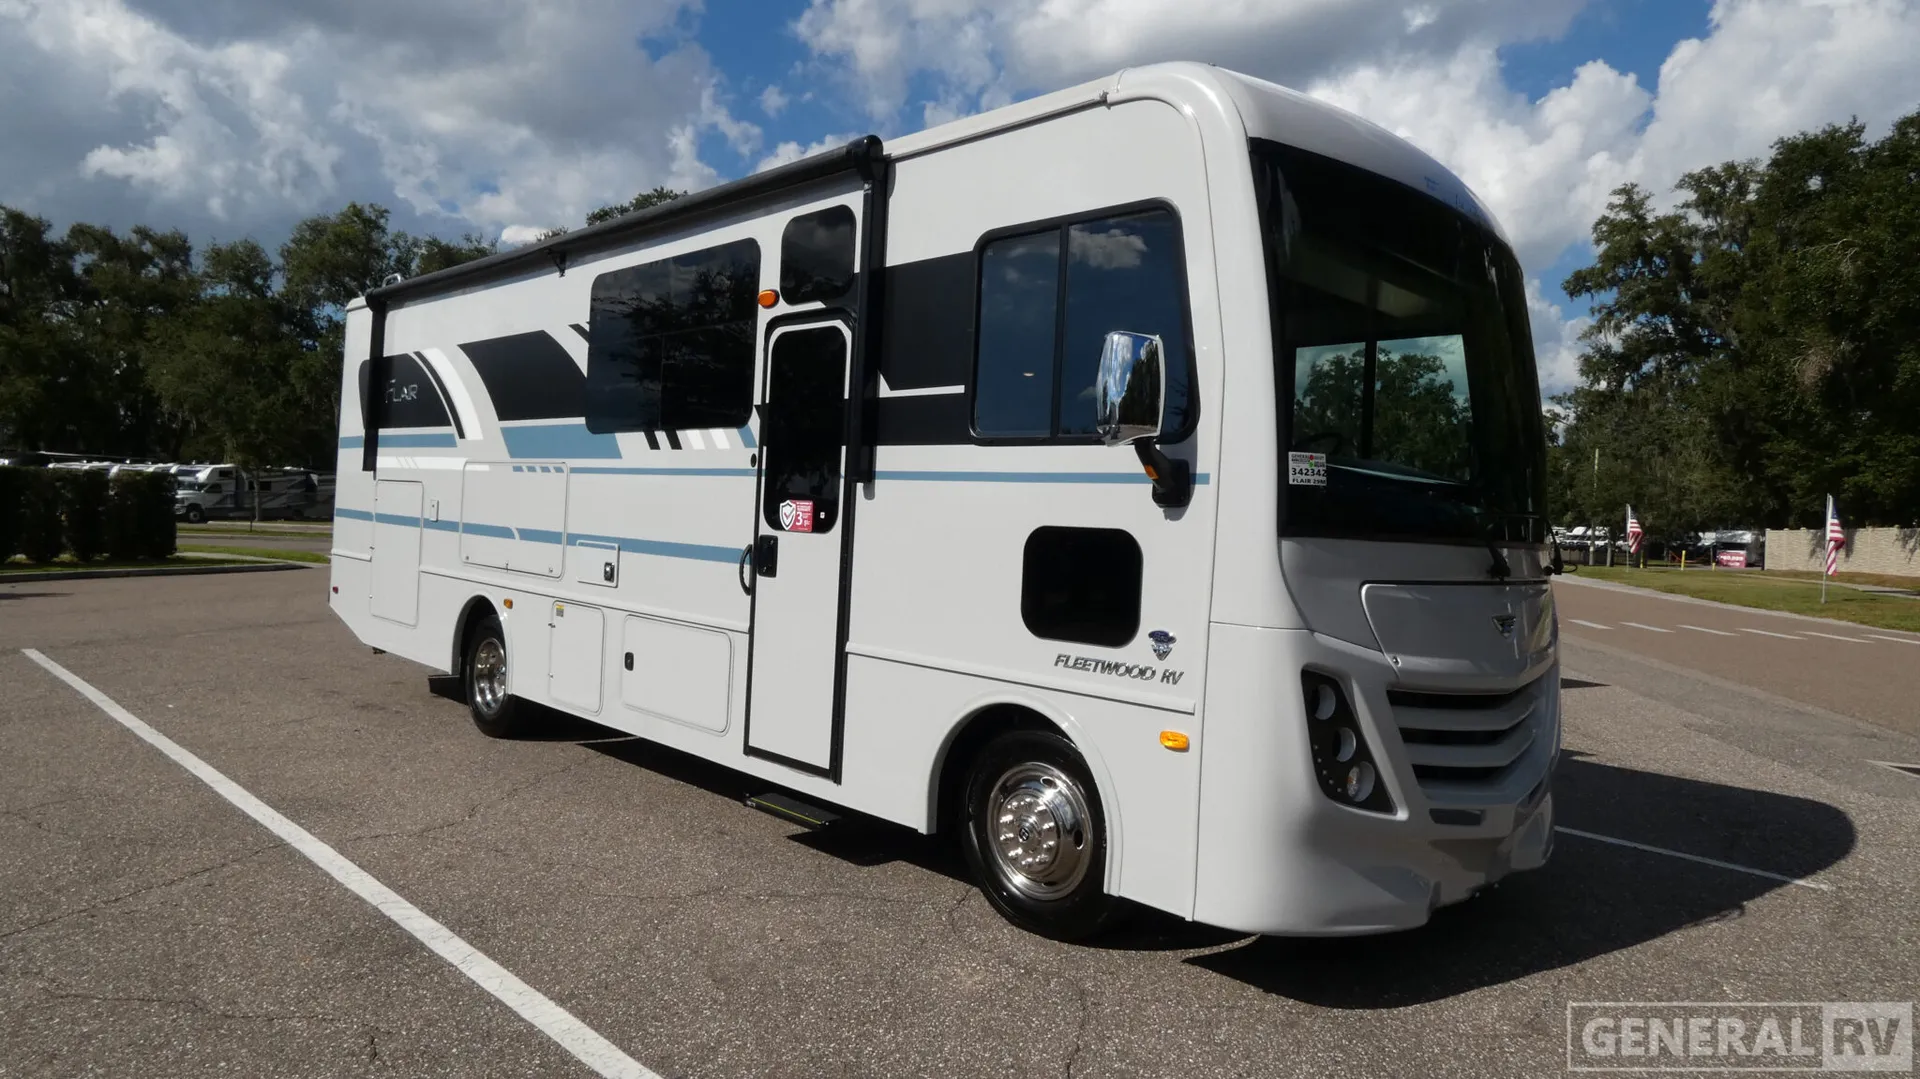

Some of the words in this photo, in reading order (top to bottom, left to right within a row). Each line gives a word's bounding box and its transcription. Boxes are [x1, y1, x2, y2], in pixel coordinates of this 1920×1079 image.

[795, 511, 803, 526] 3
[1054, 653, 1156, 681] FLEETWOOD
[1160, 668, 1184, 685] RV
